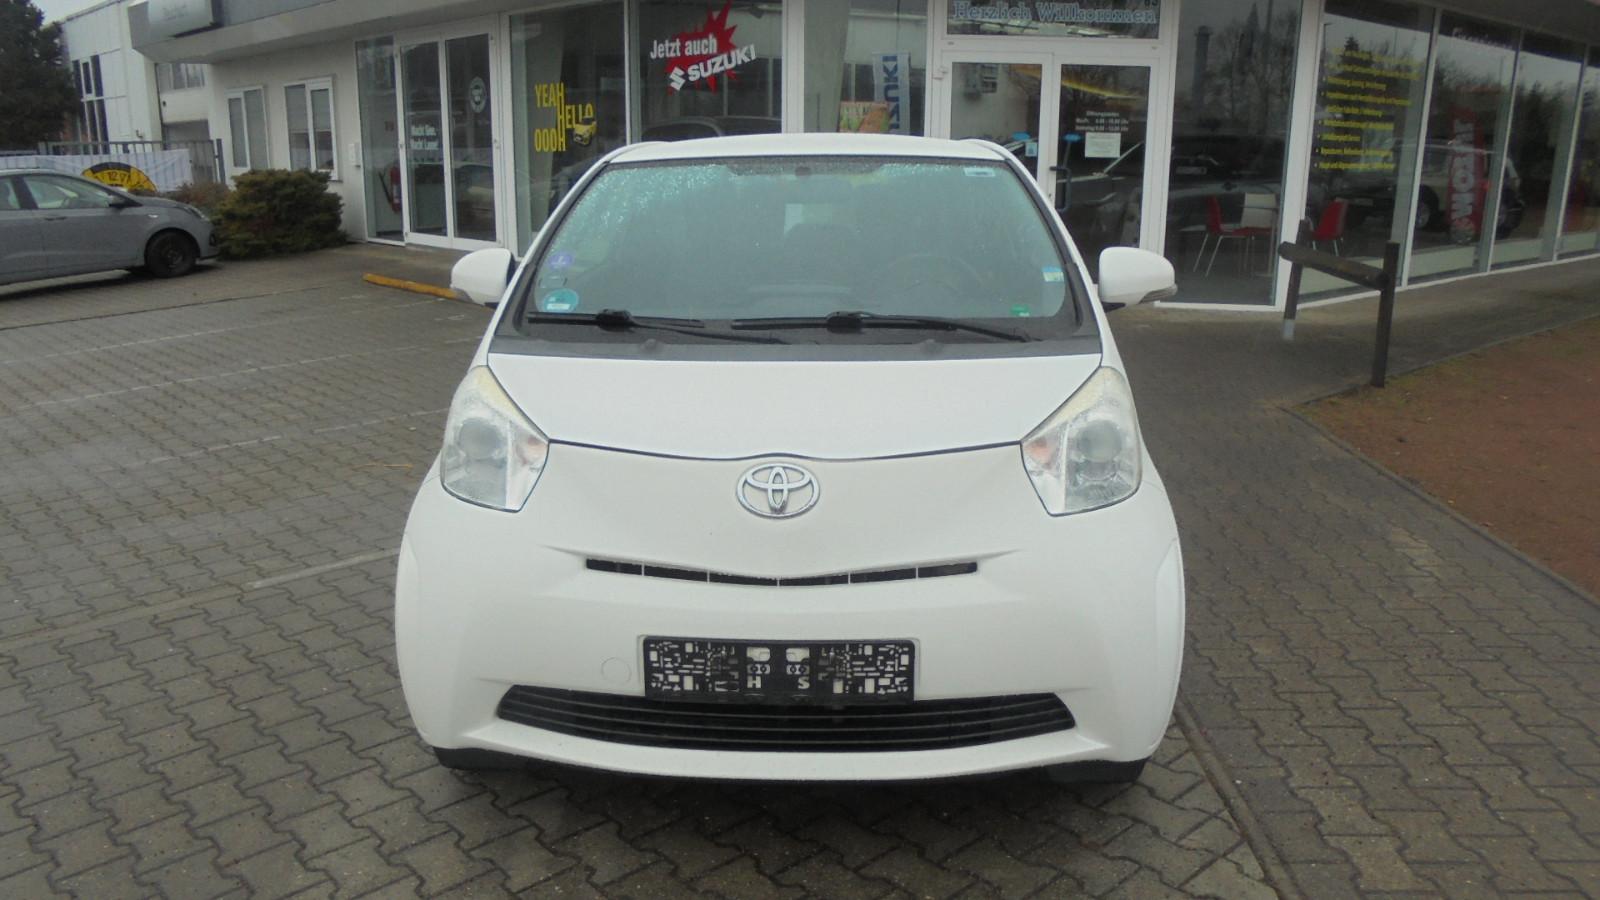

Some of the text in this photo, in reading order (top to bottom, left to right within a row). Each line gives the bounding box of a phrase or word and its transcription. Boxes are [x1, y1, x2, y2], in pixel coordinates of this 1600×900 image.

[953, 0, 1157, 24] Herzlich Willkommen
[650, 32, 718, 60] Jetzt auch
[686, 43, 757, 82] SUZUKI
[535, 82, 565, 109] YEAH
